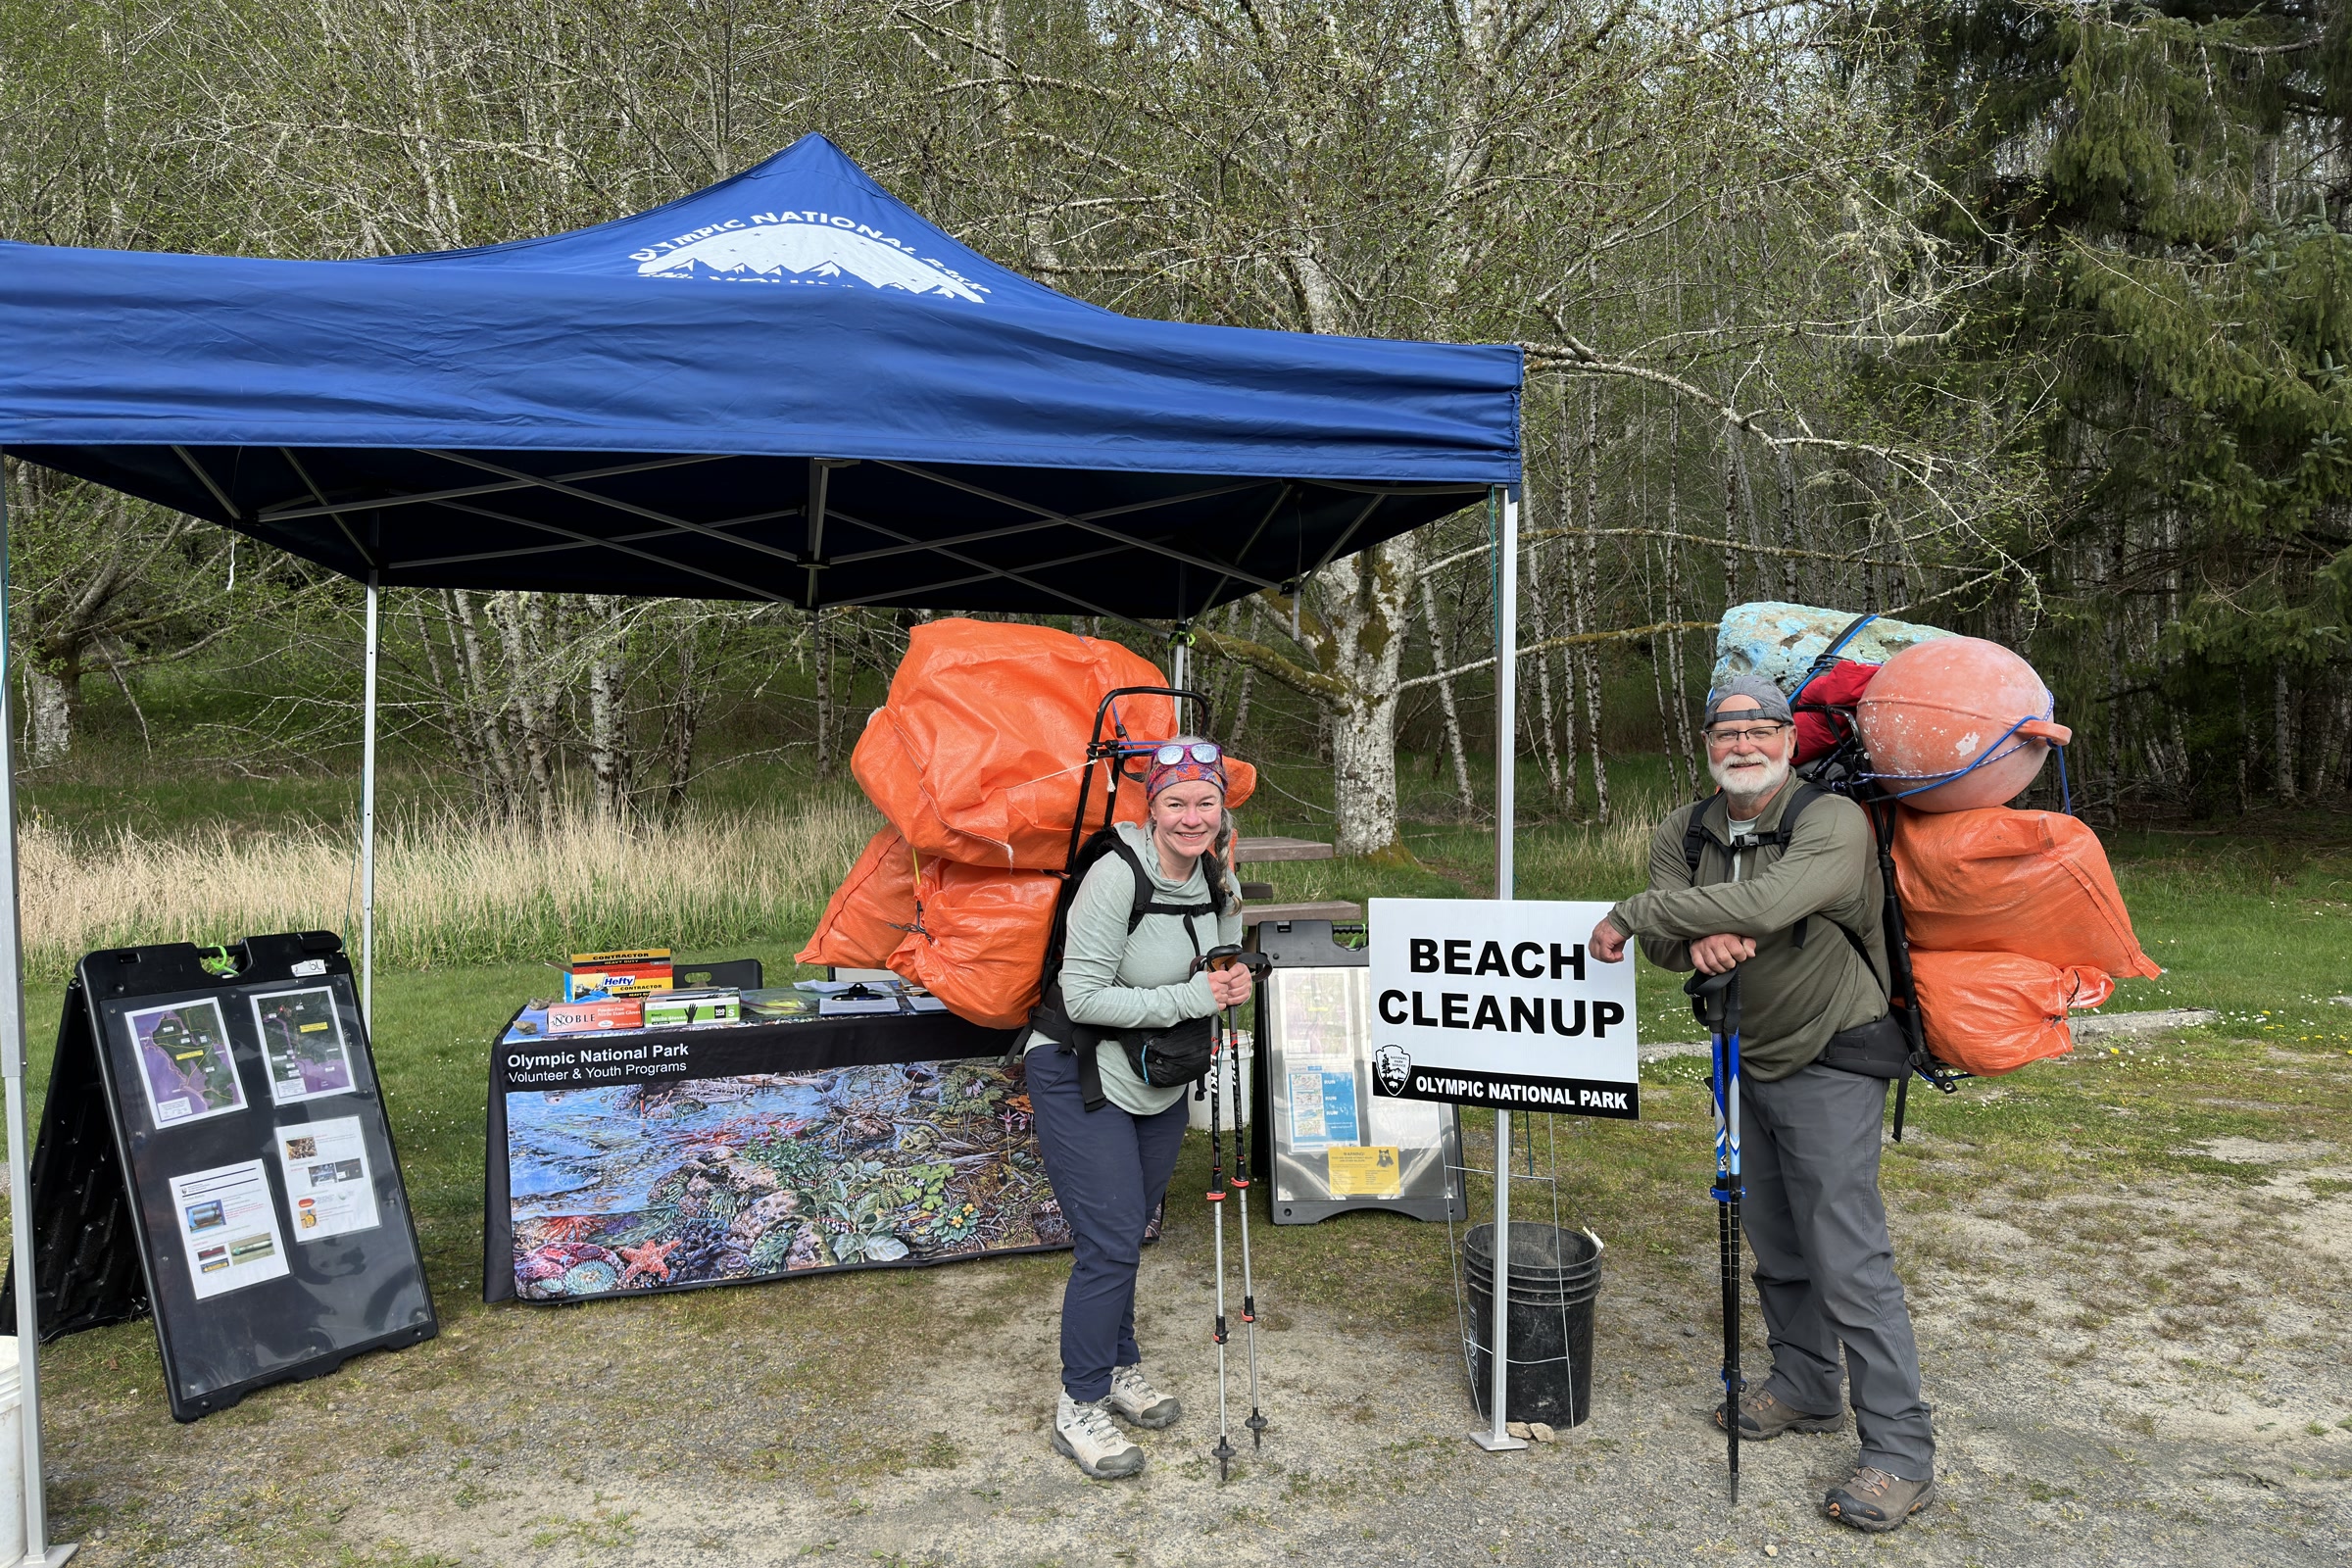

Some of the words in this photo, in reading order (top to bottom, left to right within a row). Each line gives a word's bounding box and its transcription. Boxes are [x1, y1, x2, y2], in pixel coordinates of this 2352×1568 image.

[628, 219, 747, 262] OLYMPIC
[750, 211, 917, 255] NATIONAL
[1409, 938, 1586, 981] BEACH
[604, 977, 633, 986] Hefty
[555, 1013, 595, 1025] NOBLE
[728, 1008, 735, 1017] S
[1378, 989, 1625, 1039] CLEANUP
[508, 1052, 575, 1069] Olympic
[580, 1046, 648, 1063] National
[653, 1043, 689, 1058] Park
[509, 1070, 568, 1083] Volunteer
[572, 1067, 582, 1079] &
[585, 1064, 621, 1078] Youth
[625, 1061, 687, 1076] Programs
[1416, 1076, 1484, 1099] OLYMPIC
[1489, 1083, 1576, 1105] NATIONAL
[1580, 1090, 1629, 1109] PARK
